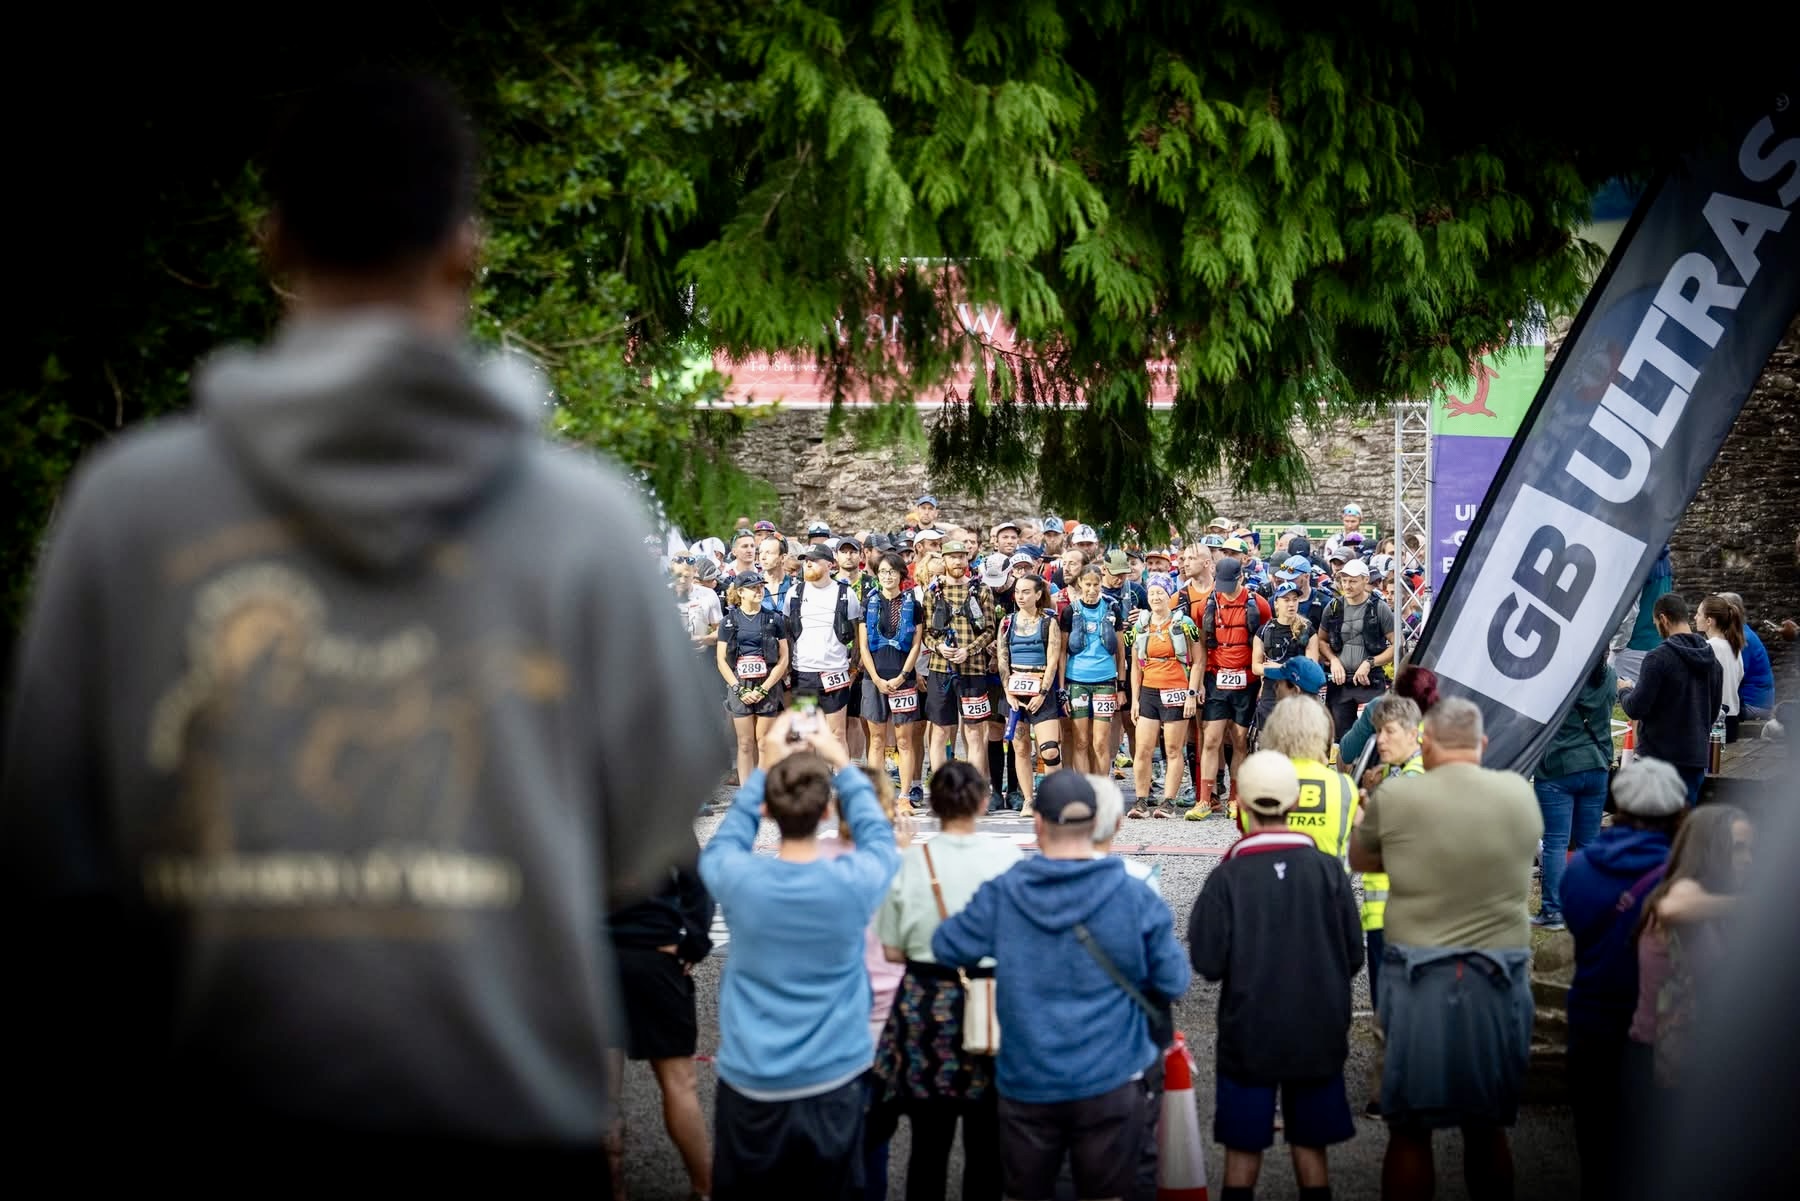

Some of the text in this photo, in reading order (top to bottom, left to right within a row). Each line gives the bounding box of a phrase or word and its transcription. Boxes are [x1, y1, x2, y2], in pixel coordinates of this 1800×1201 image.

[750, 361, 766, 372] To
[1486, 523, 1597, 681] GB
[741, 662, 762, 674] 289
[827, 672, 847, 687] 351
[1013, 680, 1034, 691] 257
[1221, 674, 1241, 685] 220
[894, 696, 915, 708] 270
[1166, 691, 1187, 703] 298
[967, 702, 988, 715] 255
[1097, 701, 1115, 712] 239
[1298, 784, 1321, 808] B
[1289, 815, 1326, 826] TRAS
